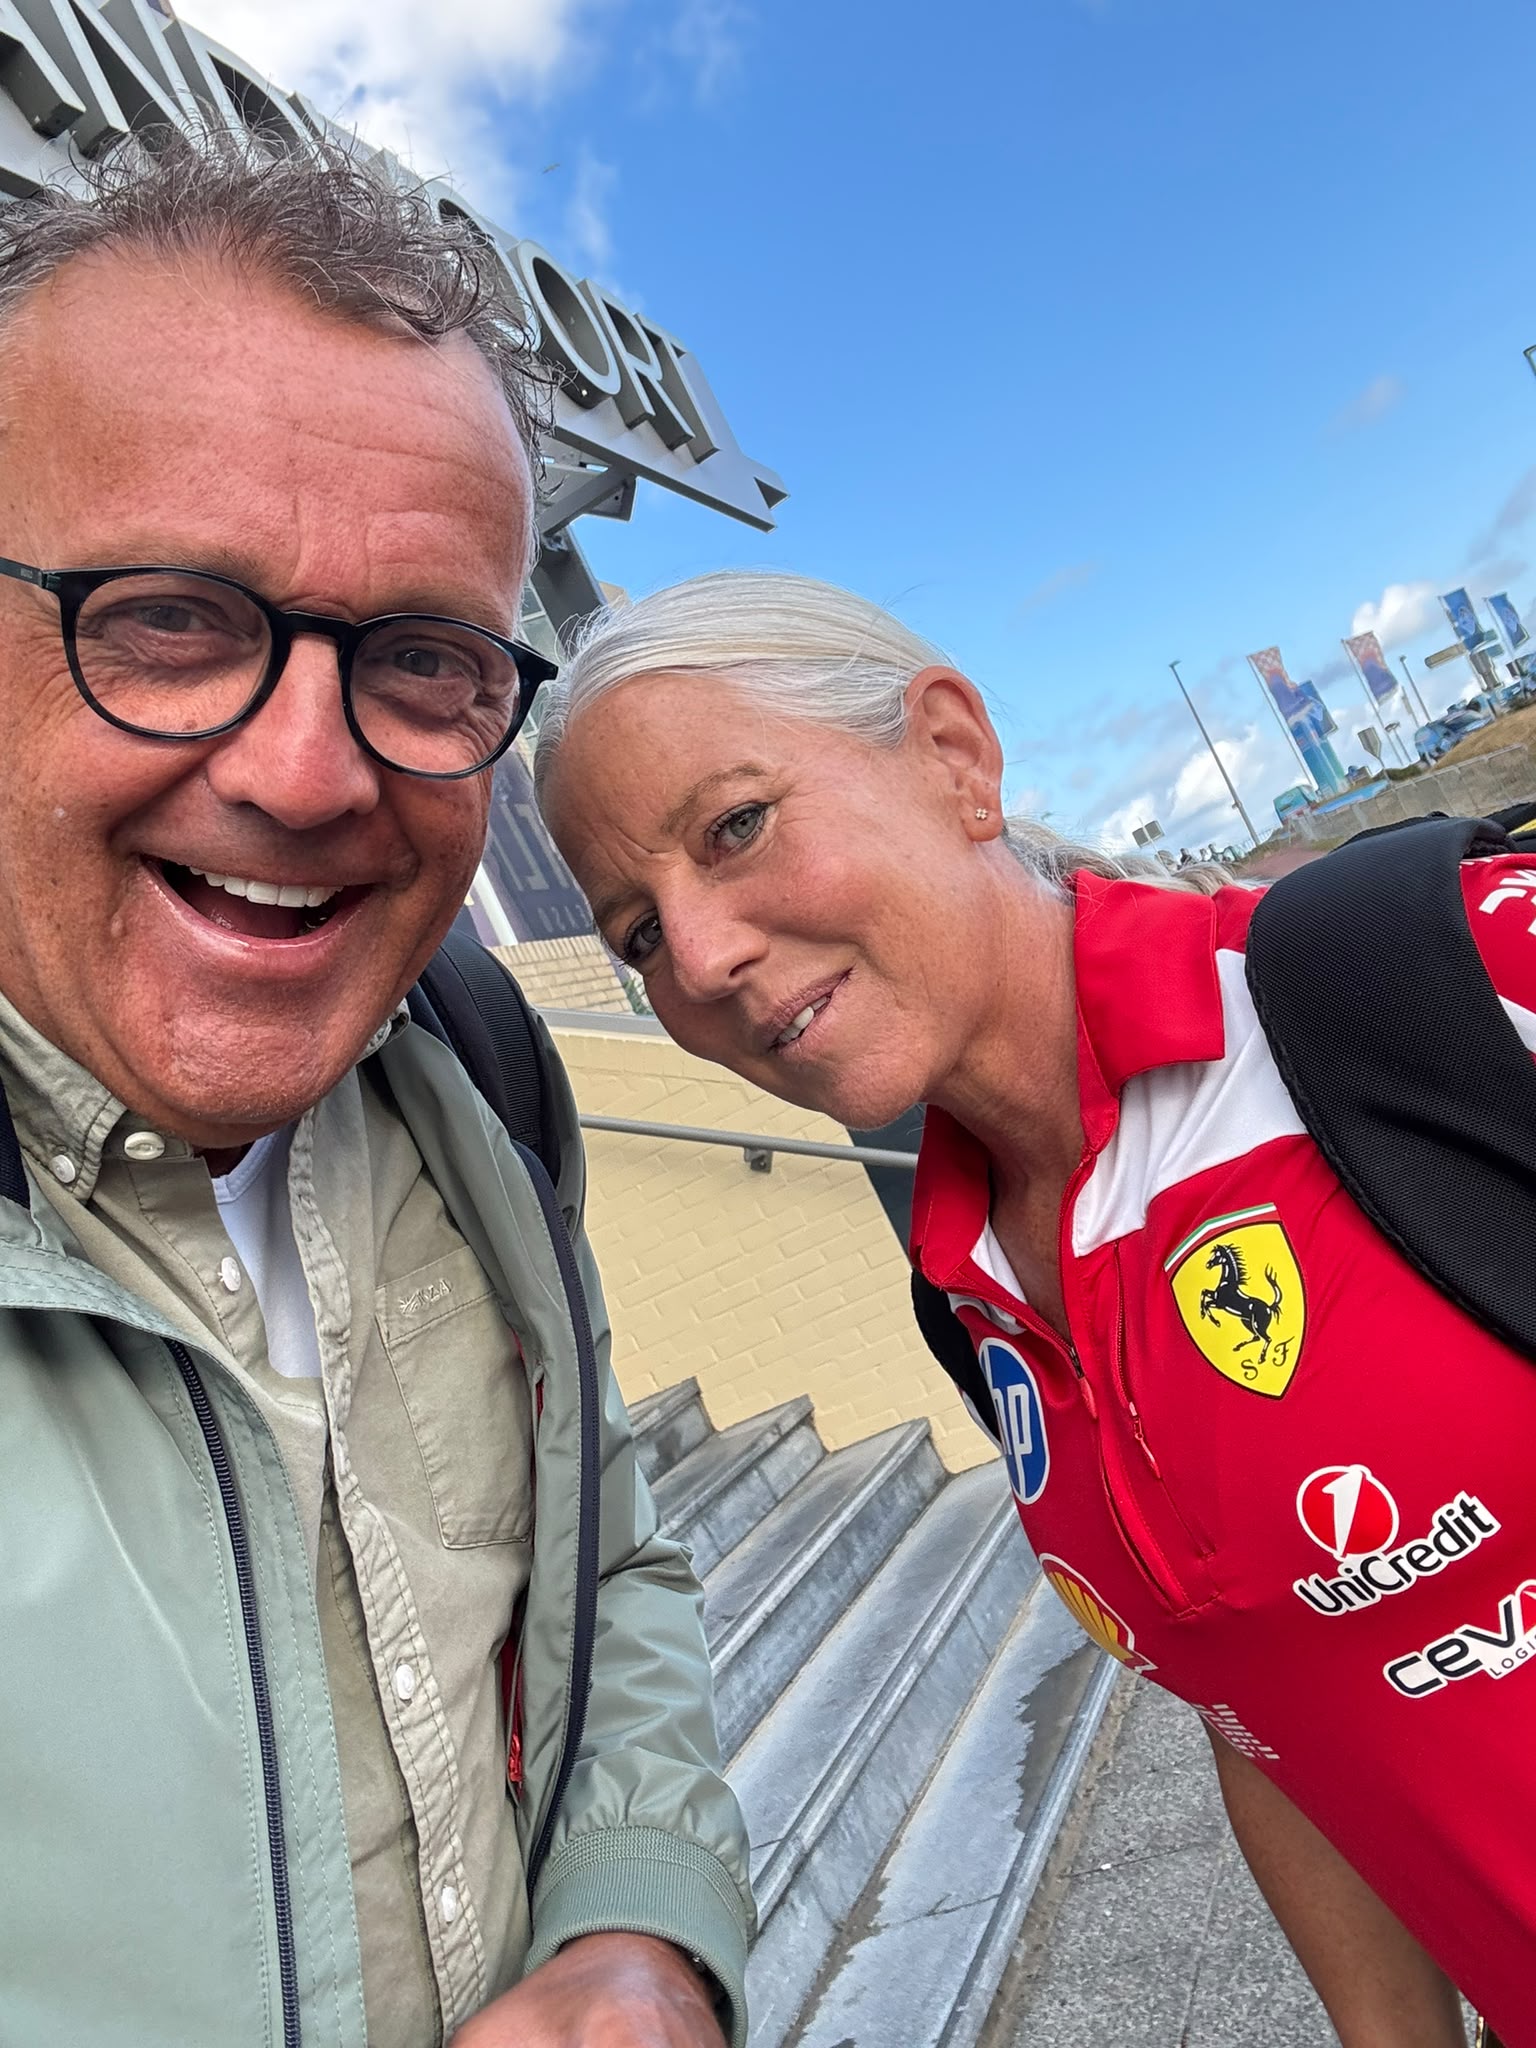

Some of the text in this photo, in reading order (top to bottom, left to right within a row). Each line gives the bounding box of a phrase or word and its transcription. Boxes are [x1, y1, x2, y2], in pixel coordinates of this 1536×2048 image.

[1241, 1336, 1295, 1381] S F
[1298, 1498, 1494, 1613] UniCredit
